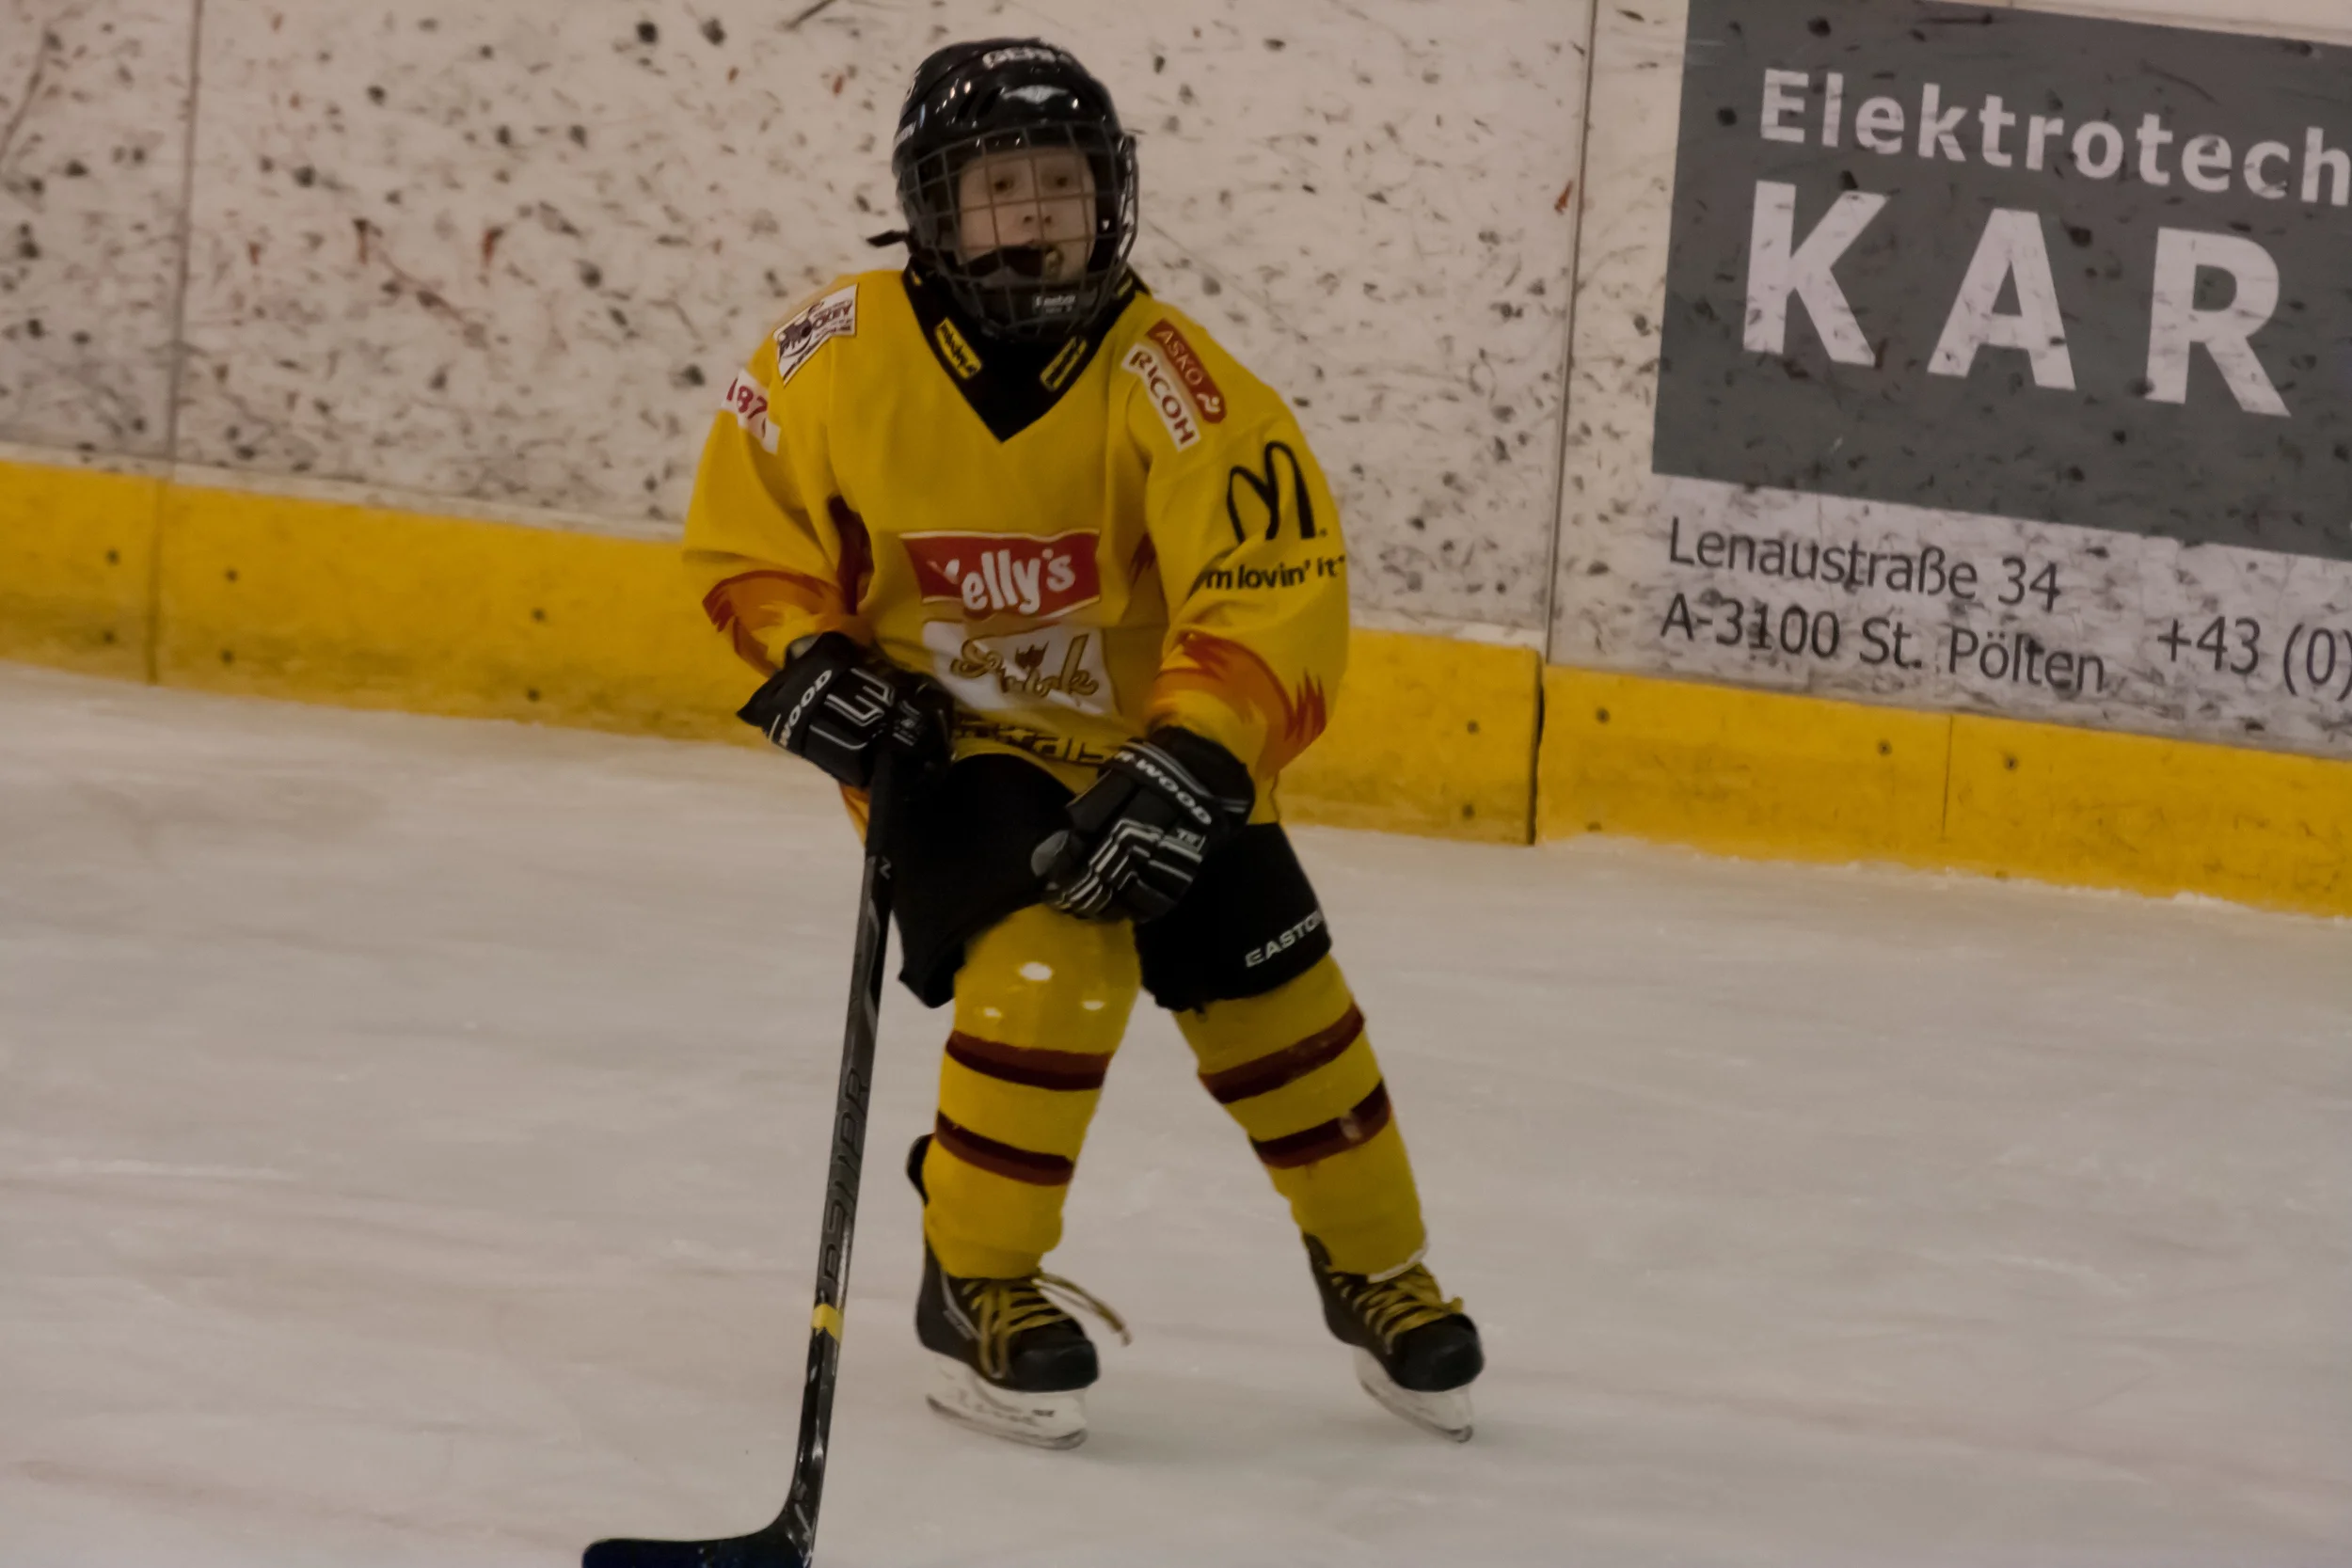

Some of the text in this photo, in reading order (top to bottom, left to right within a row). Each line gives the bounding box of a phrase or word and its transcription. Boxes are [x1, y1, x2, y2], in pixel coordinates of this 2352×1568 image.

[1760, 69, 2351, 207] Elektrotech
[1743, 181, 2291, 418] KAR
[1131, 351, 1196, 445] RICOH
[1670, 515, 2061, 613] Lenaustraße 34
[1661, 592, 2105, 693] A-3100 St. Pölten
[2157, 615, 2352, 702] +43 (0)
[1244, 909, 1324, 968] EASTO
